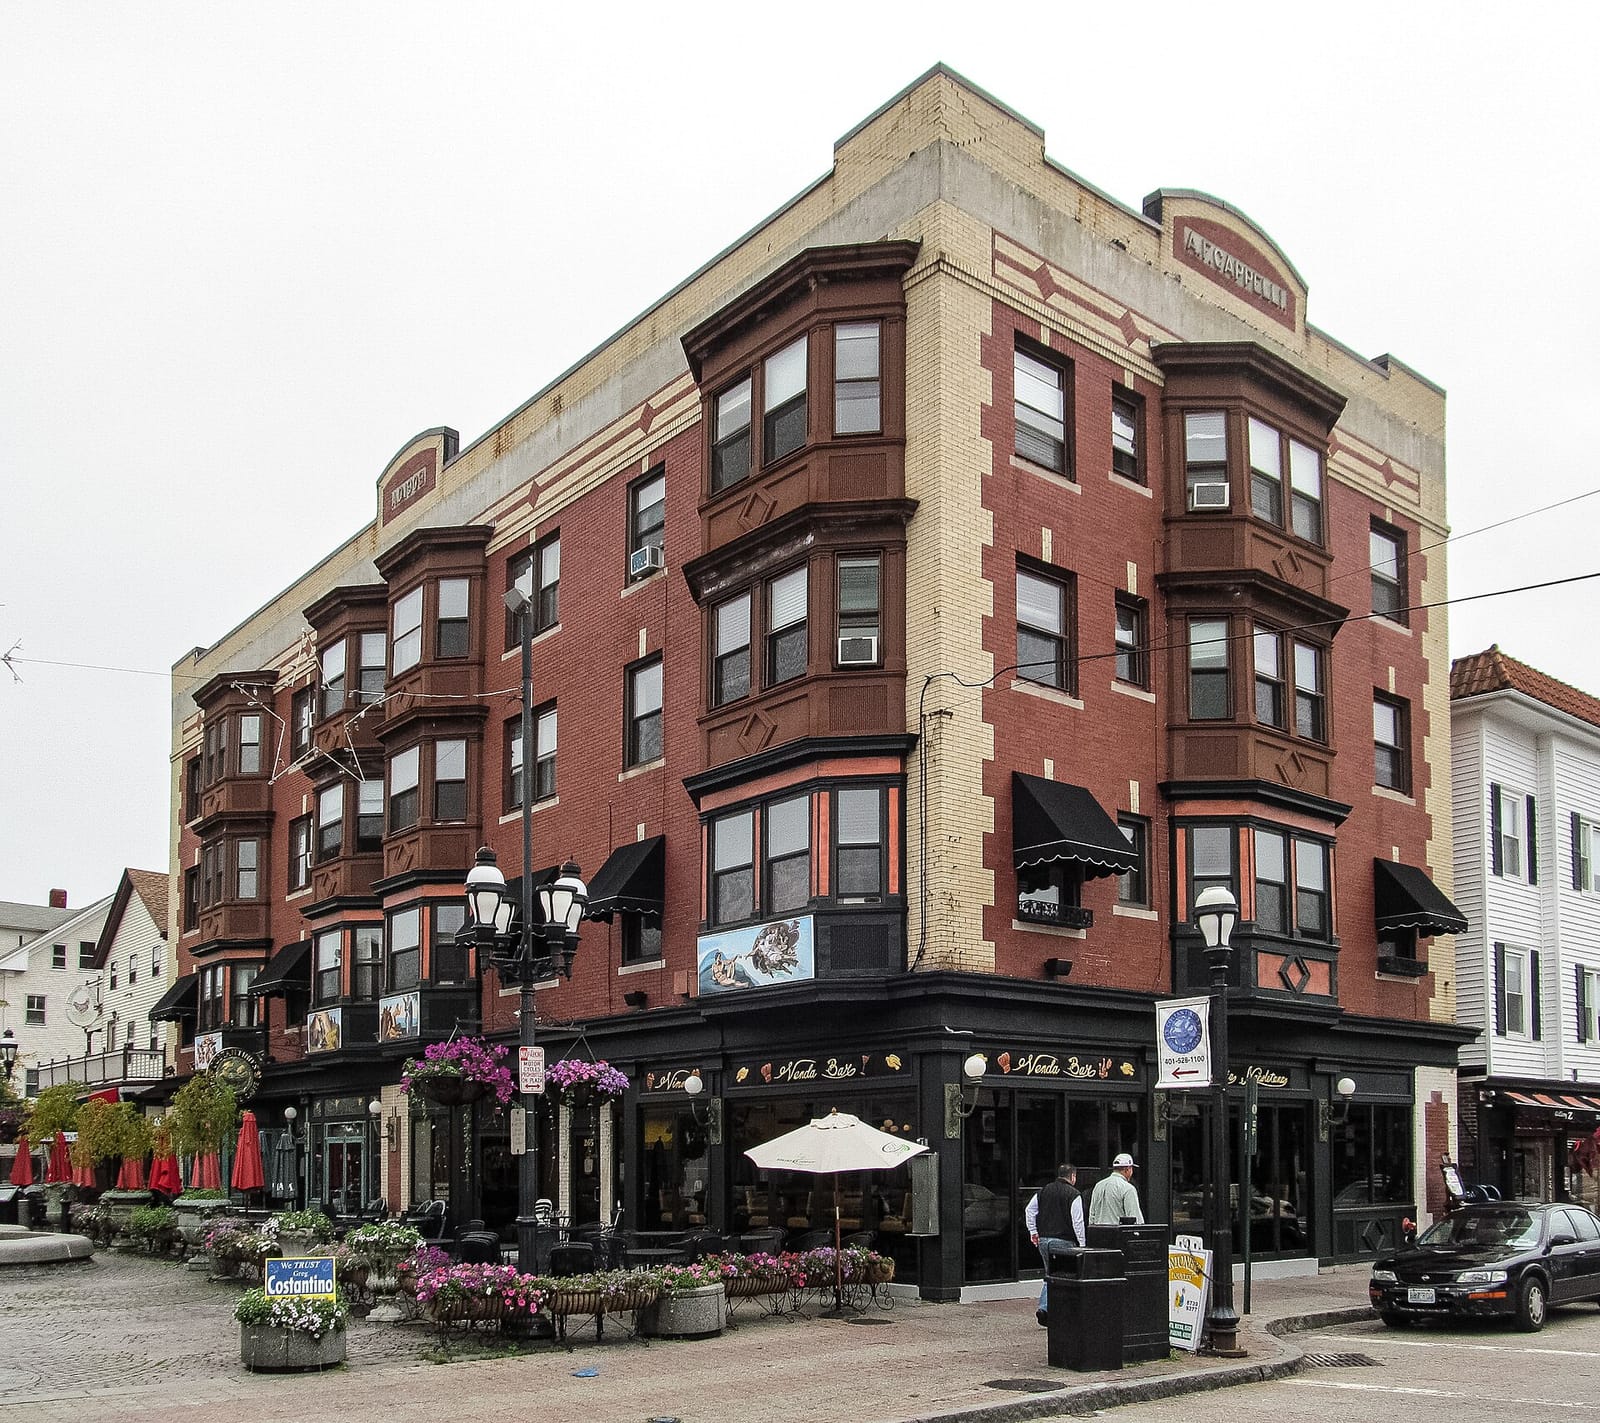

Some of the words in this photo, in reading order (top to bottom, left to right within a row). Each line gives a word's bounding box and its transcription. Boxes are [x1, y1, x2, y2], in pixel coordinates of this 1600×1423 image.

[821, 1058, 857, 1079] Bar
[1063, 1056, 1096, 1078] Bar
[294, 1261, 320, 1269] TRUST
[268, 1275, 333, 1295] Costantino
